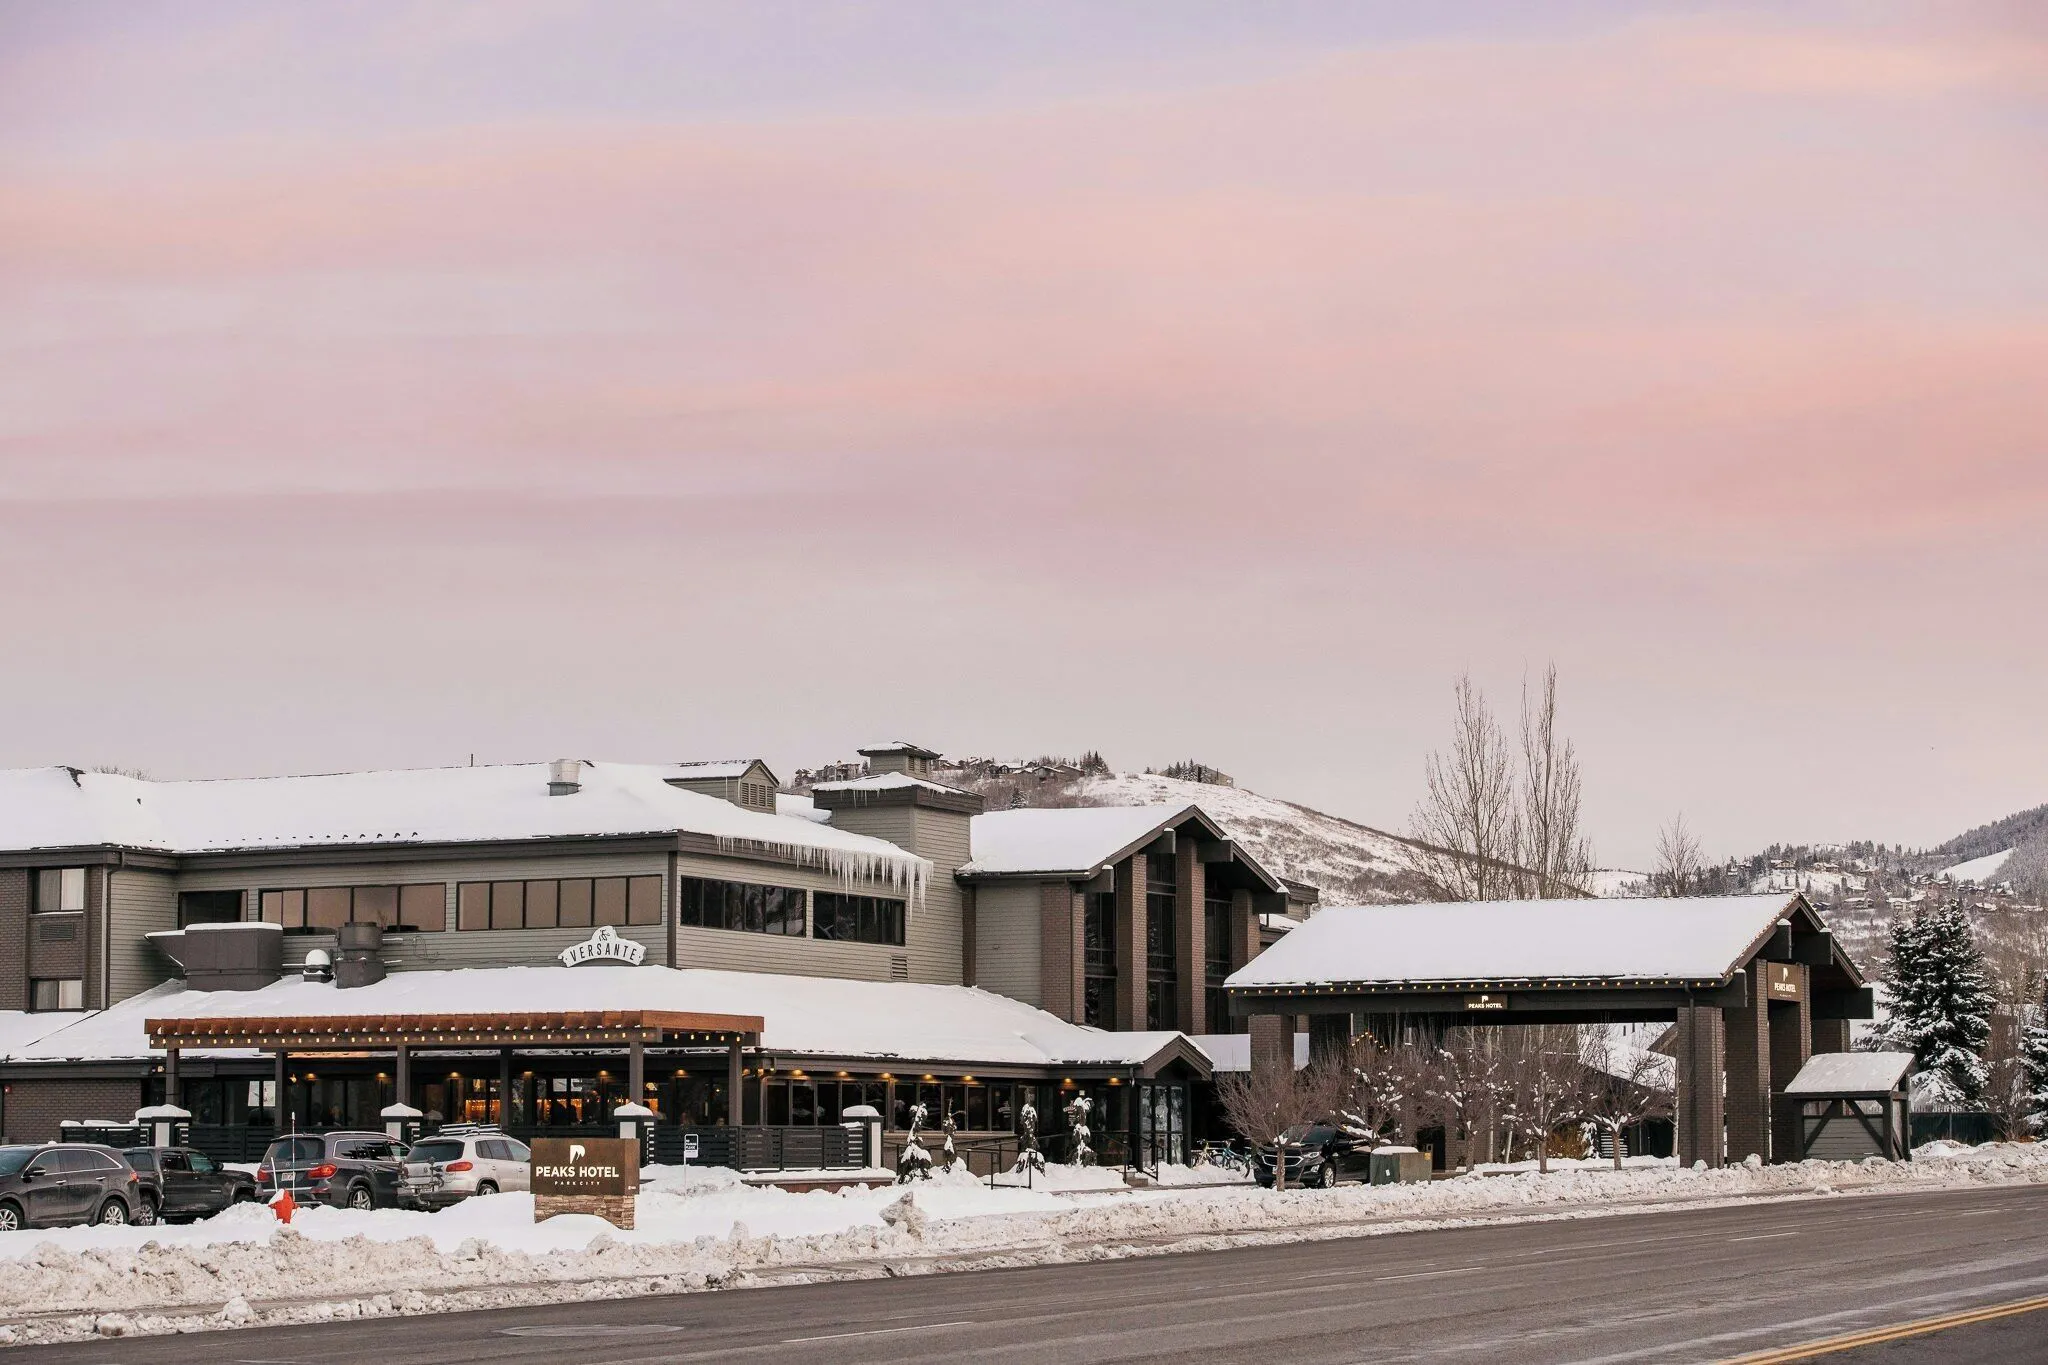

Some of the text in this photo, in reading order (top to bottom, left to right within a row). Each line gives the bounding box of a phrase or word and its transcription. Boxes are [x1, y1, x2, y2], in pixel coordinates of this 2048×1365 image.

[570, 943, 637, 962] VERSANTE
[535, 1166, 620, 1178] PEAKS HOTEL
